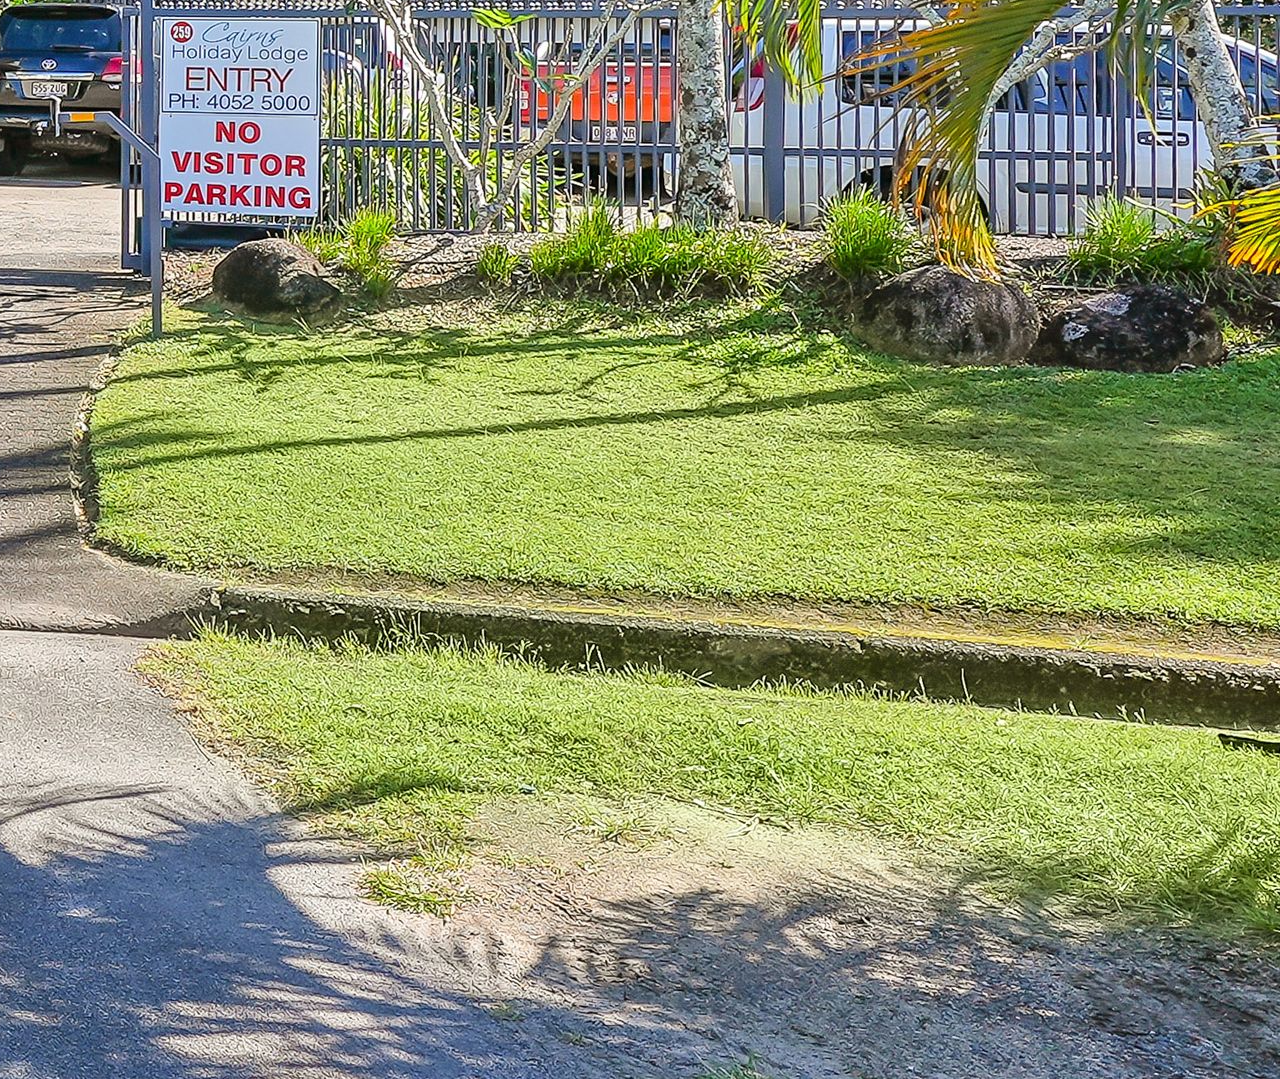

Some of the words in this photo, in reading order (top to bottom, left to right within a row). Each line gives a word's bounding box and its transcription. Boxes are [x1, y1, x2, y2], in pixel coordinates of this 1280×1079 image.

[172, 24, 192, 42] 259
[202, 21, 284, 49] Cairns
[171, 44, 243, 63] Holiday
[248, 45, 309, 64] Lodge
[185, 66, 294, 93] ENTRY
[168, 93, 199, 109] PH:
[206, 94, 254, 110] 4052
[261, 95, 311, 111] 5000
[215, 121, 261, 144] NO
[171, 151, 306, 177] VISITOR
[164, 181, 312, 209] PARKING
